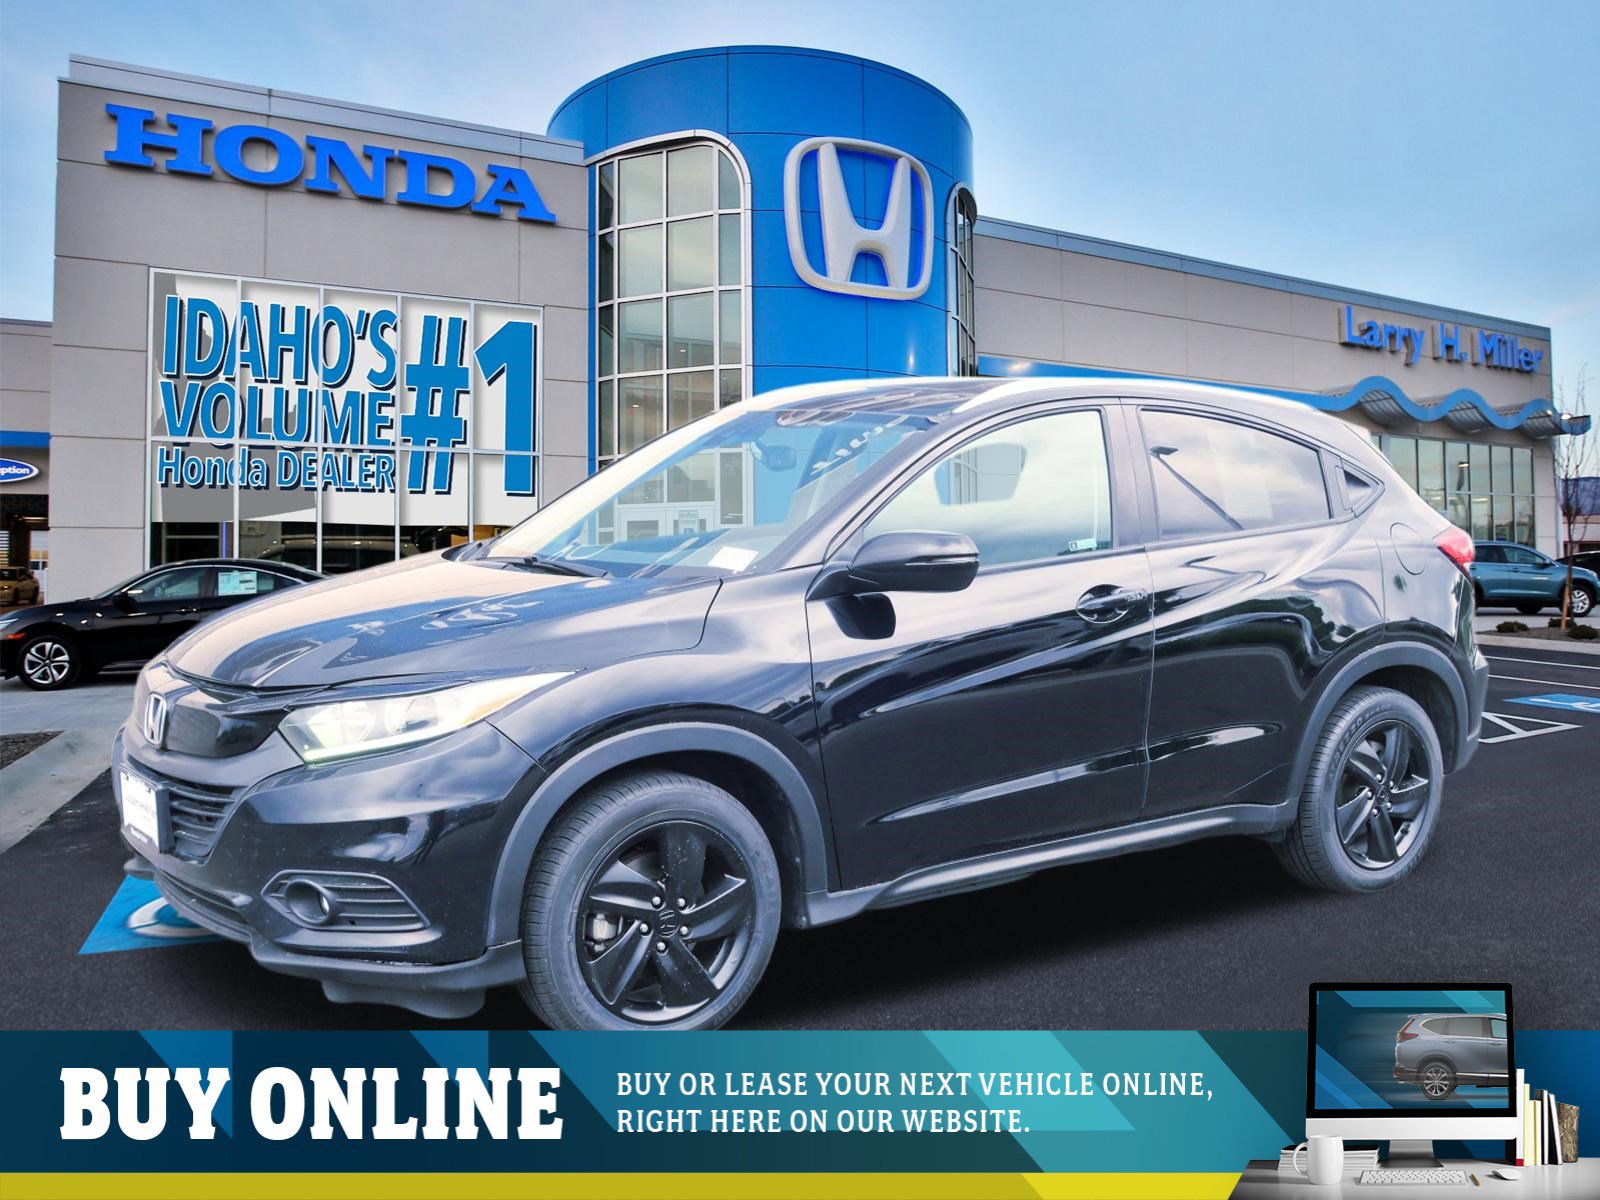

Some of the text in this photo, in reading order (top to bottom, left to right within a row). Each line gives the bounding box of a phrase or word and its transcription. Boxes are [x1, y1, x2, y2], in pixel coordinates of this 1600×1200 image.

[104, 103, 557, 223] HONDA
[163, 295, 398, 389] IDAHO'S
[1340, 306, 1544, 372] Larry H. Miller
[160, 380, 395, 449] VOLUME
[401, 315, 537, 496] #1
[157, 446, 395, 491] Honda DEALER
